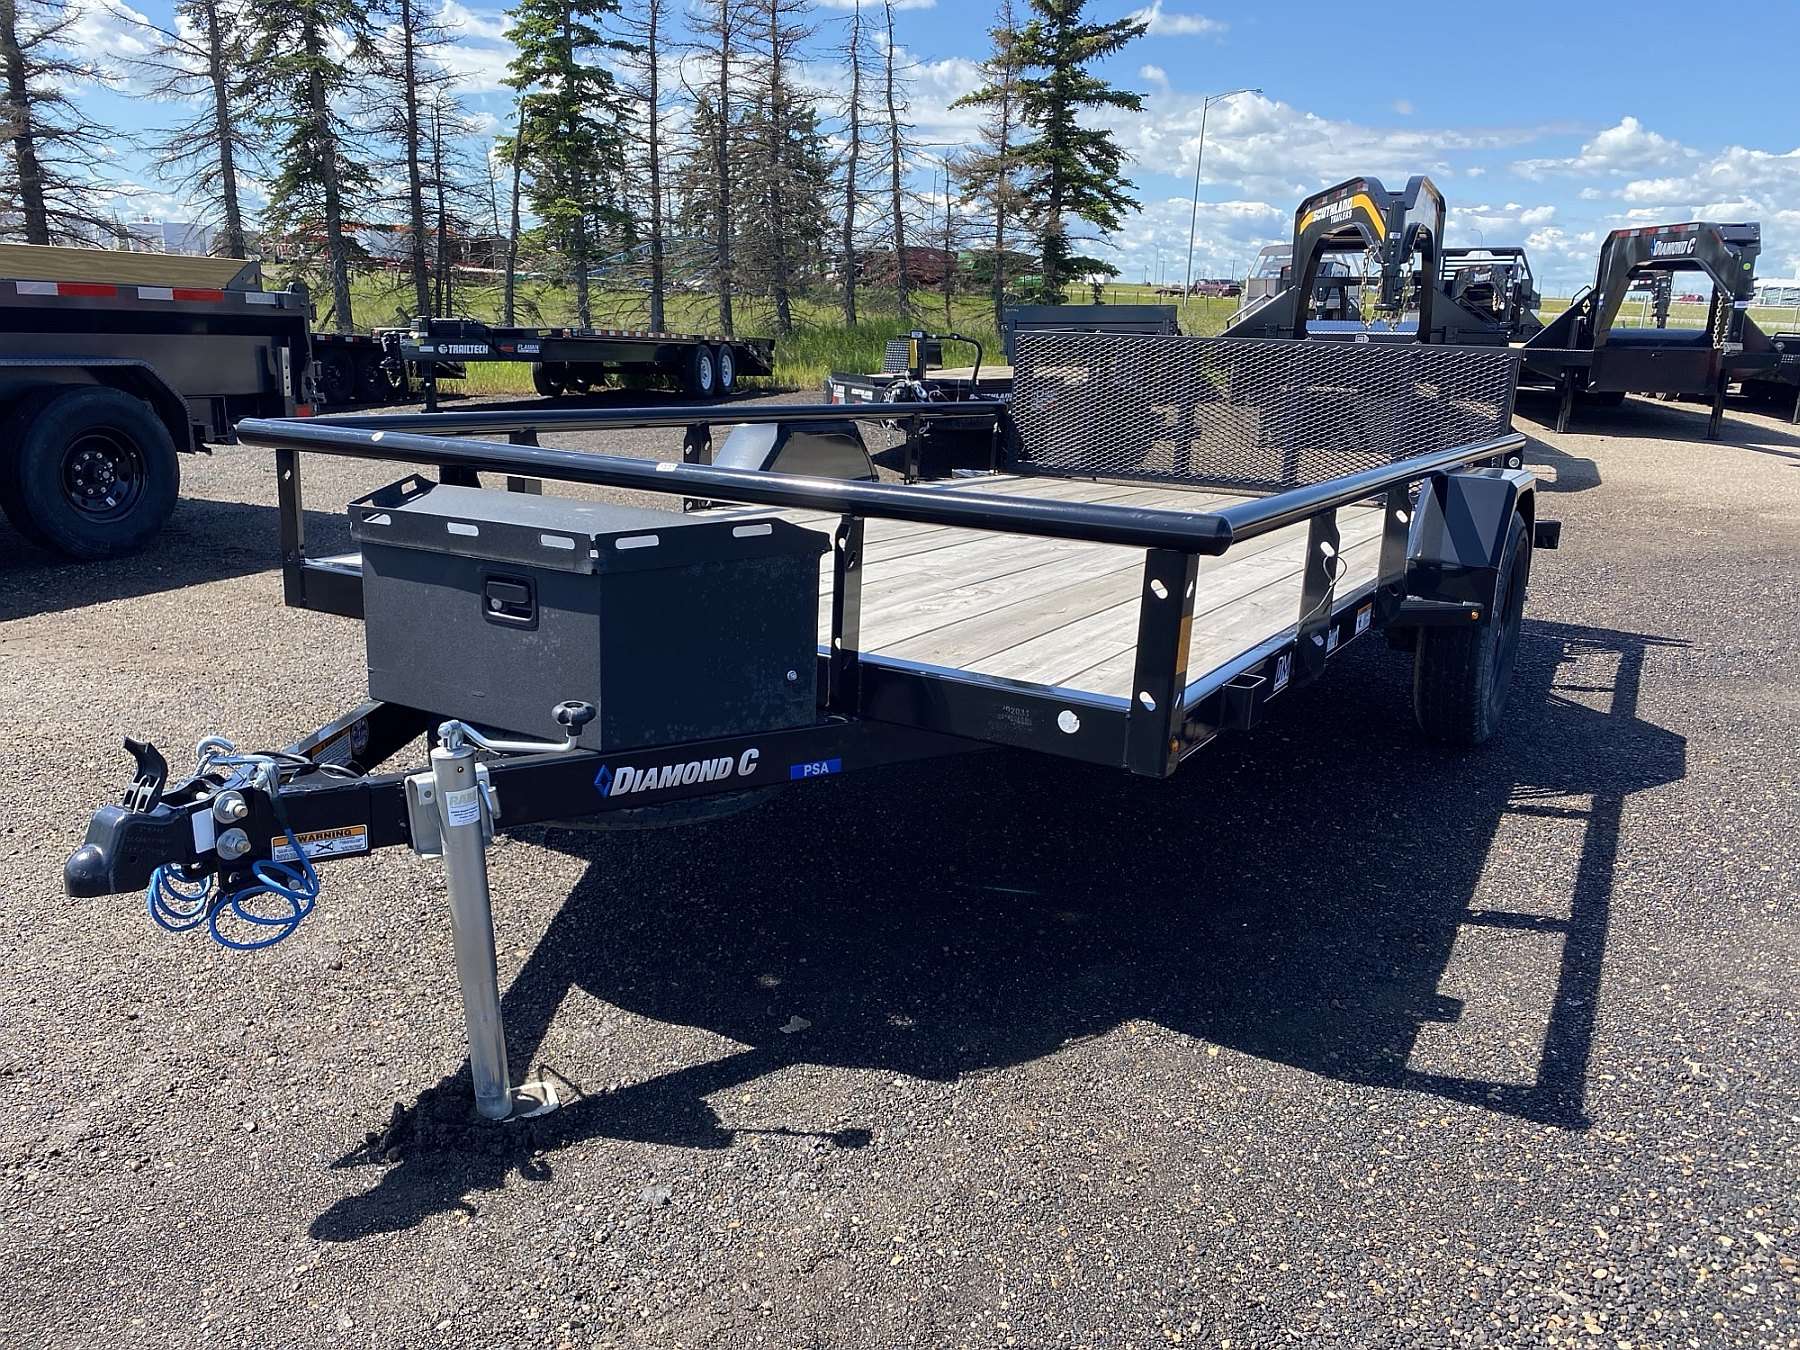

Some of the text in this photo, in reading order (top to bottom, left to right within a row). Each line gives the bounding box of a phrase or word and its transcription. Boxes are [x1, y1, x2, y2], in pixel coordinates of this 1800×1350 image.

[1312, 197, 1354, 222] SOUTHLAND
[1330, 209, 1353, 224] TRAILERS
[1653, 237, 1697, 256] DIAMOND C
[448, 344, 489, 354] TRAILTECH
[609, 748, 760, 796] DIAMOND C
[803, 761, 829, 777] PSA
[297, 829, 352, 843] WARNING
